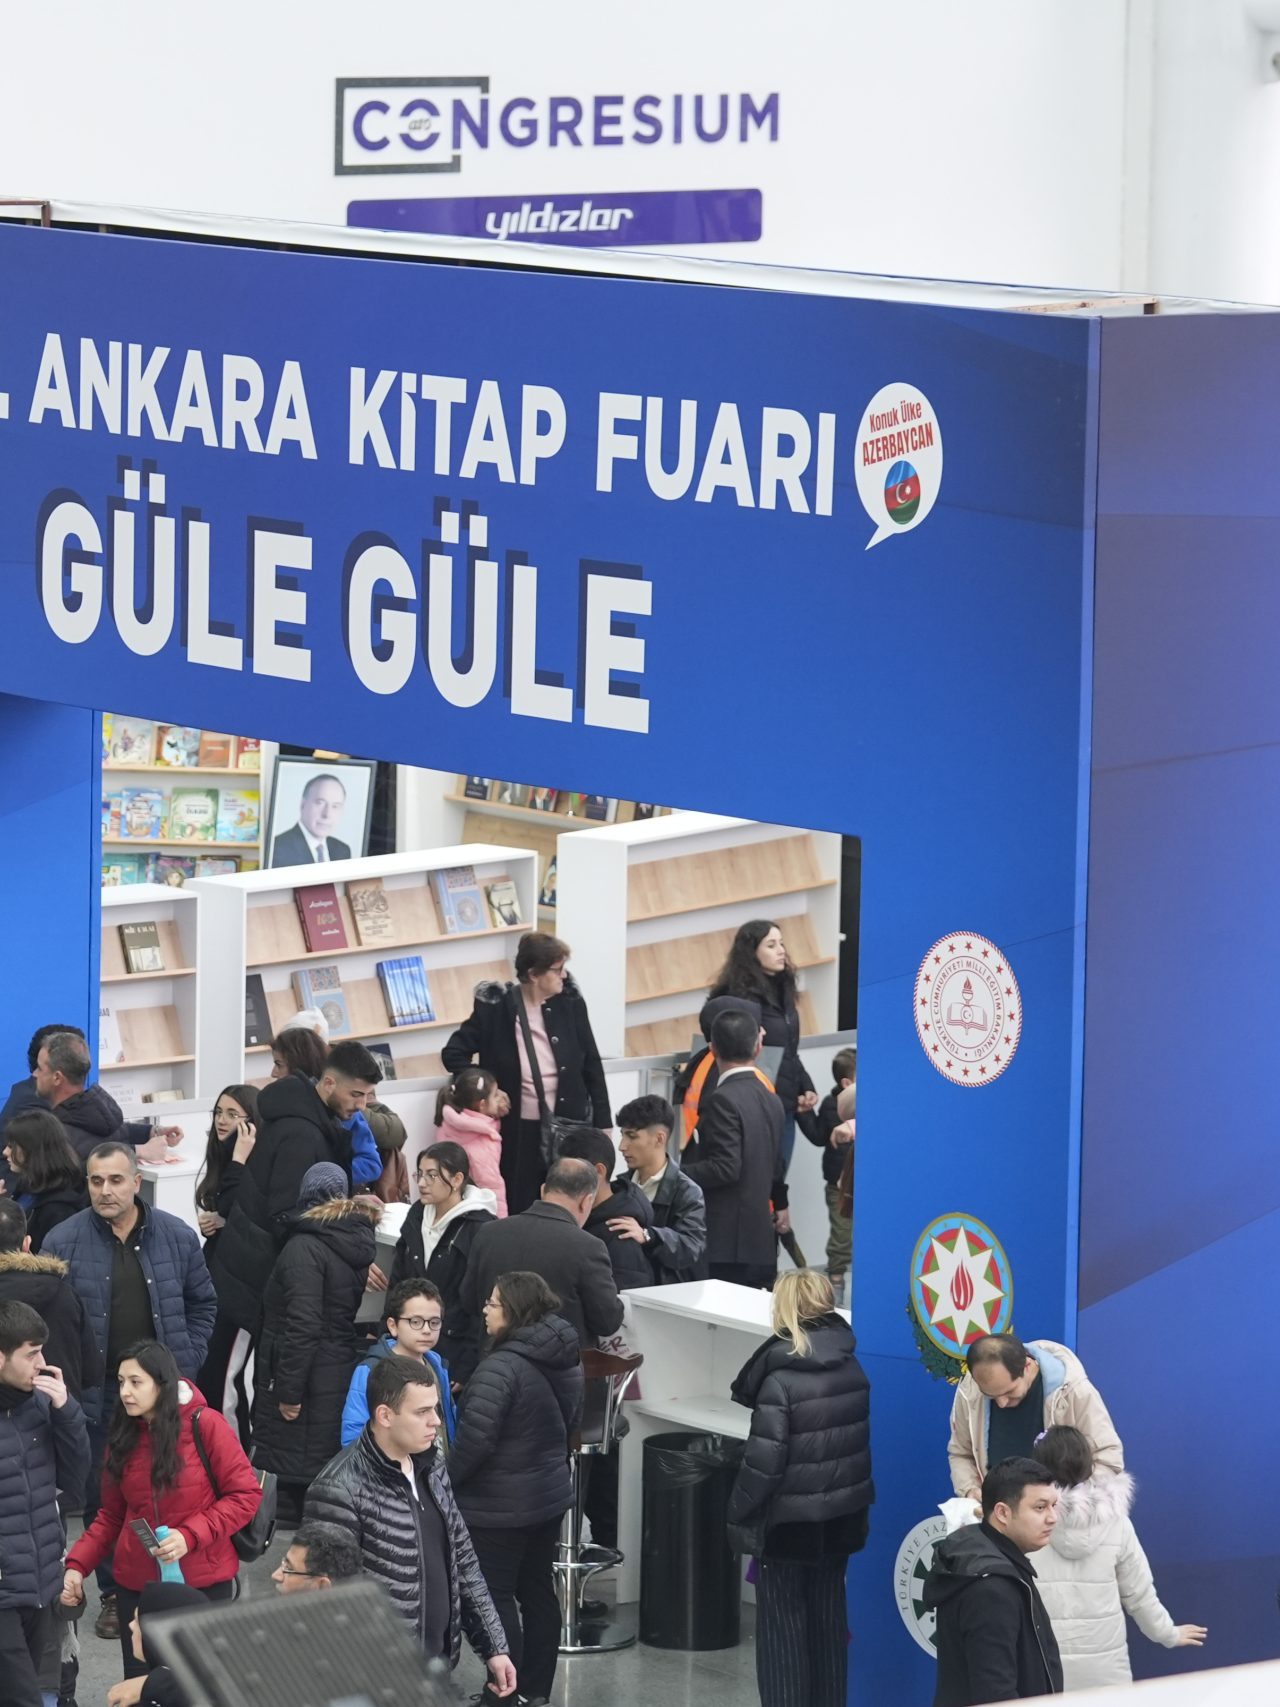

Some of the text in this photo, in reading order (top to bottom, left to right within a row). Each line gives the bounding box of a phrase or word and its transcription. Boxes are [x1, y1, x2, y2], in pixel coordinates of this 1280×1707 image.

[353, 93, 780, 151] CONGRESIUM
[28, 333, 318, 460] ANKARA
[348, 366, 567, 485] KİTAP
[596, 391, 836, 516] FUARI
[862, 422, 934, 467] AZERBAYCAN
[870, 400, 922, 433] Konuk Ülke
[41, 469, 653, 734] GÜLE GÜLE
